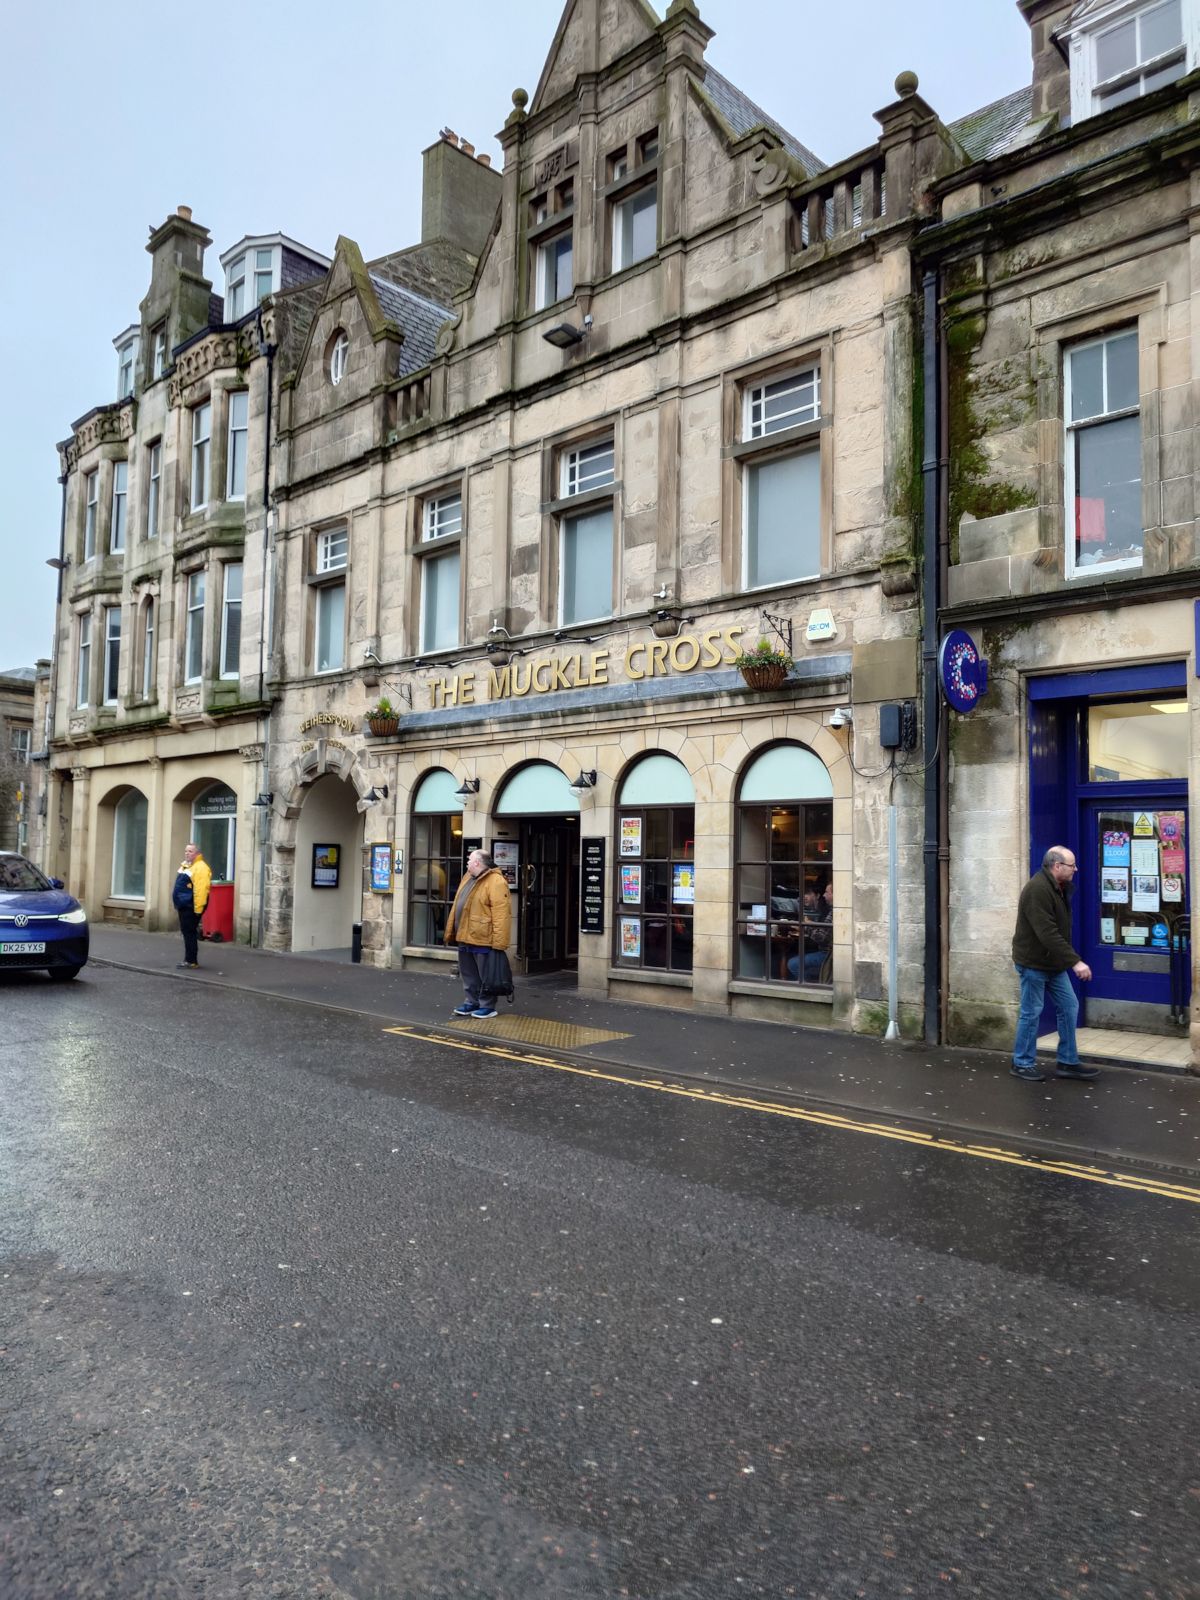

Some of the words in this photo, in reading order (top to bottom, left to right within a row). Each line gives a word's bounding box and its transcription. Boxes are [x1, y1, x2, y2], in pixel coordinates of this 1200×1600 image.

[428, 672, 475, 709] THE
[487, 649, 609, 699] MUCKLE
[624, 626, 744, 680] CROSS
[299, 713, 354, 733] WETHERSPOON
[3, 943, 26, 952] DK25
[27, 943, 44, 952] YXS
